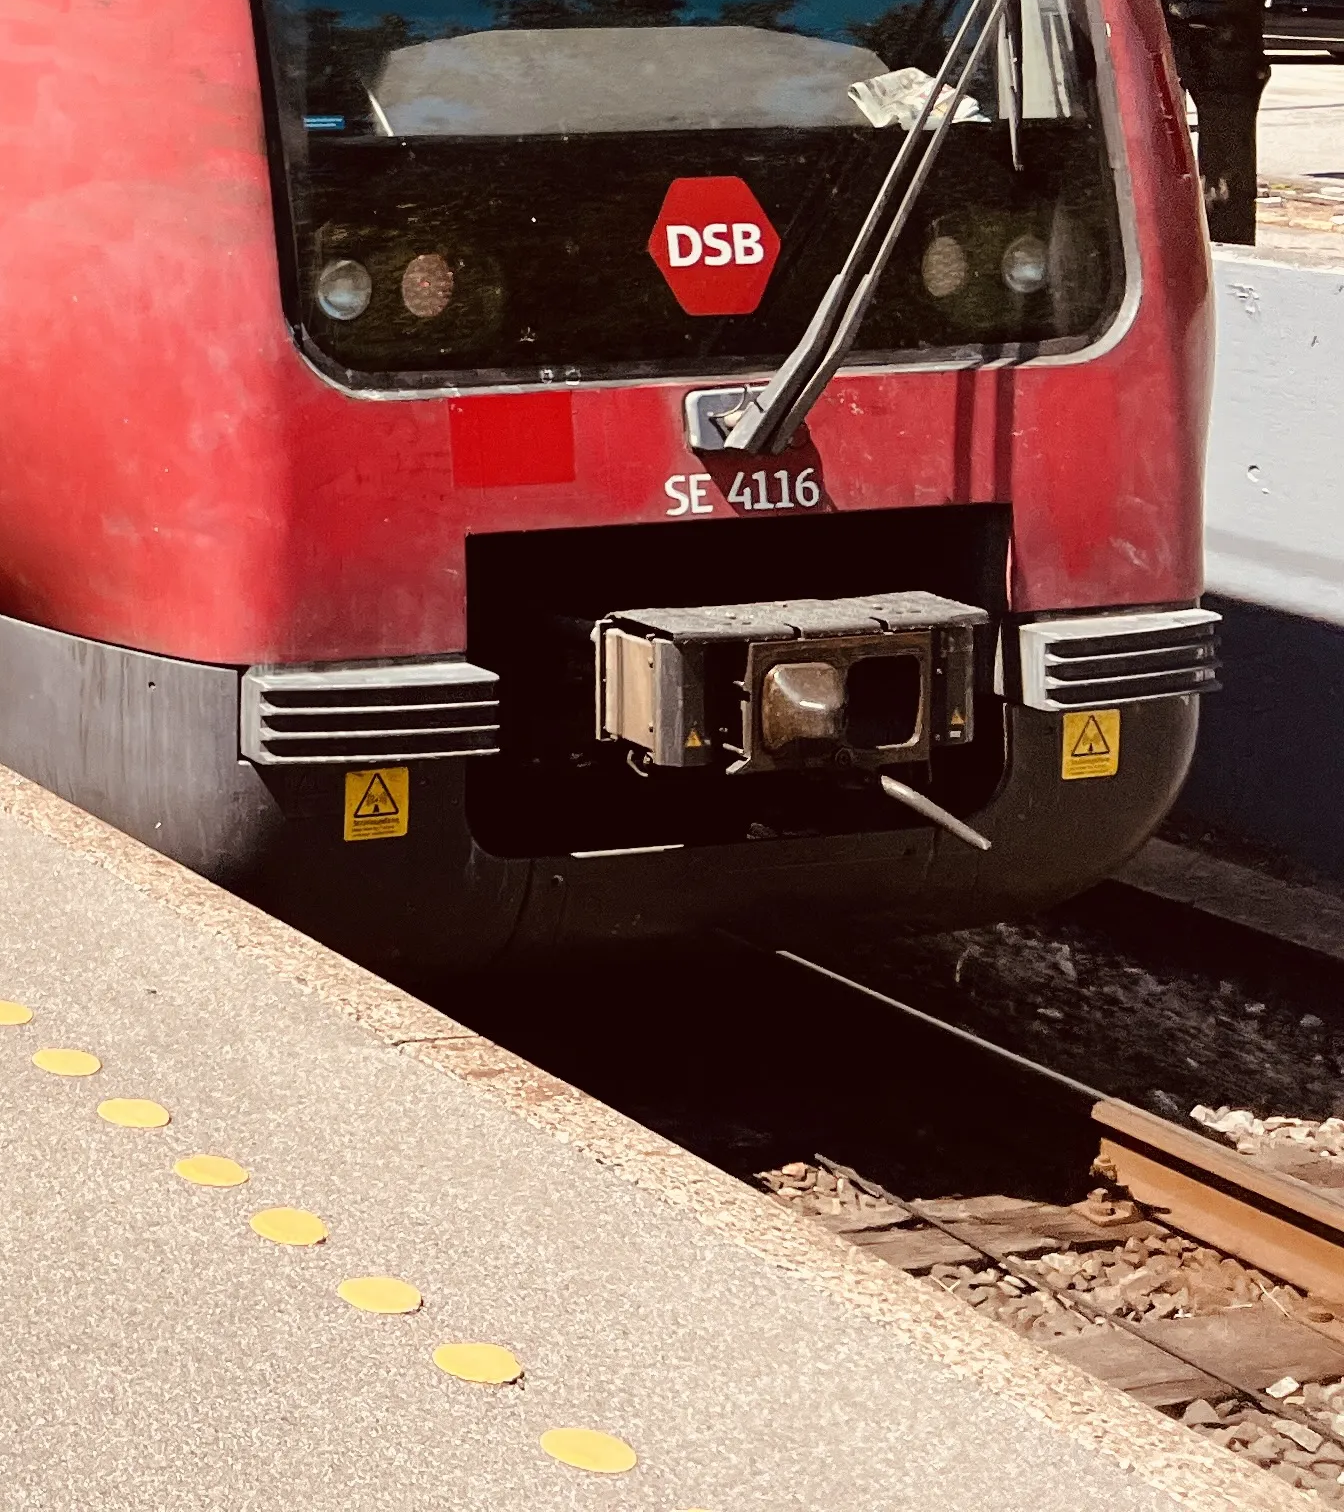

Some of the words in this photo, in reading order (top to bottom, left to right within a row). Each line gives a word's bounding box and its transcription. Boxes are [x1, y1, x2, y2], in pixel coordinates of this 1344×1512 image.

[665, 222, 765, 268] DSB
[664, 473, 714, 517] SE
[726, 467, 821, 512] 4116
